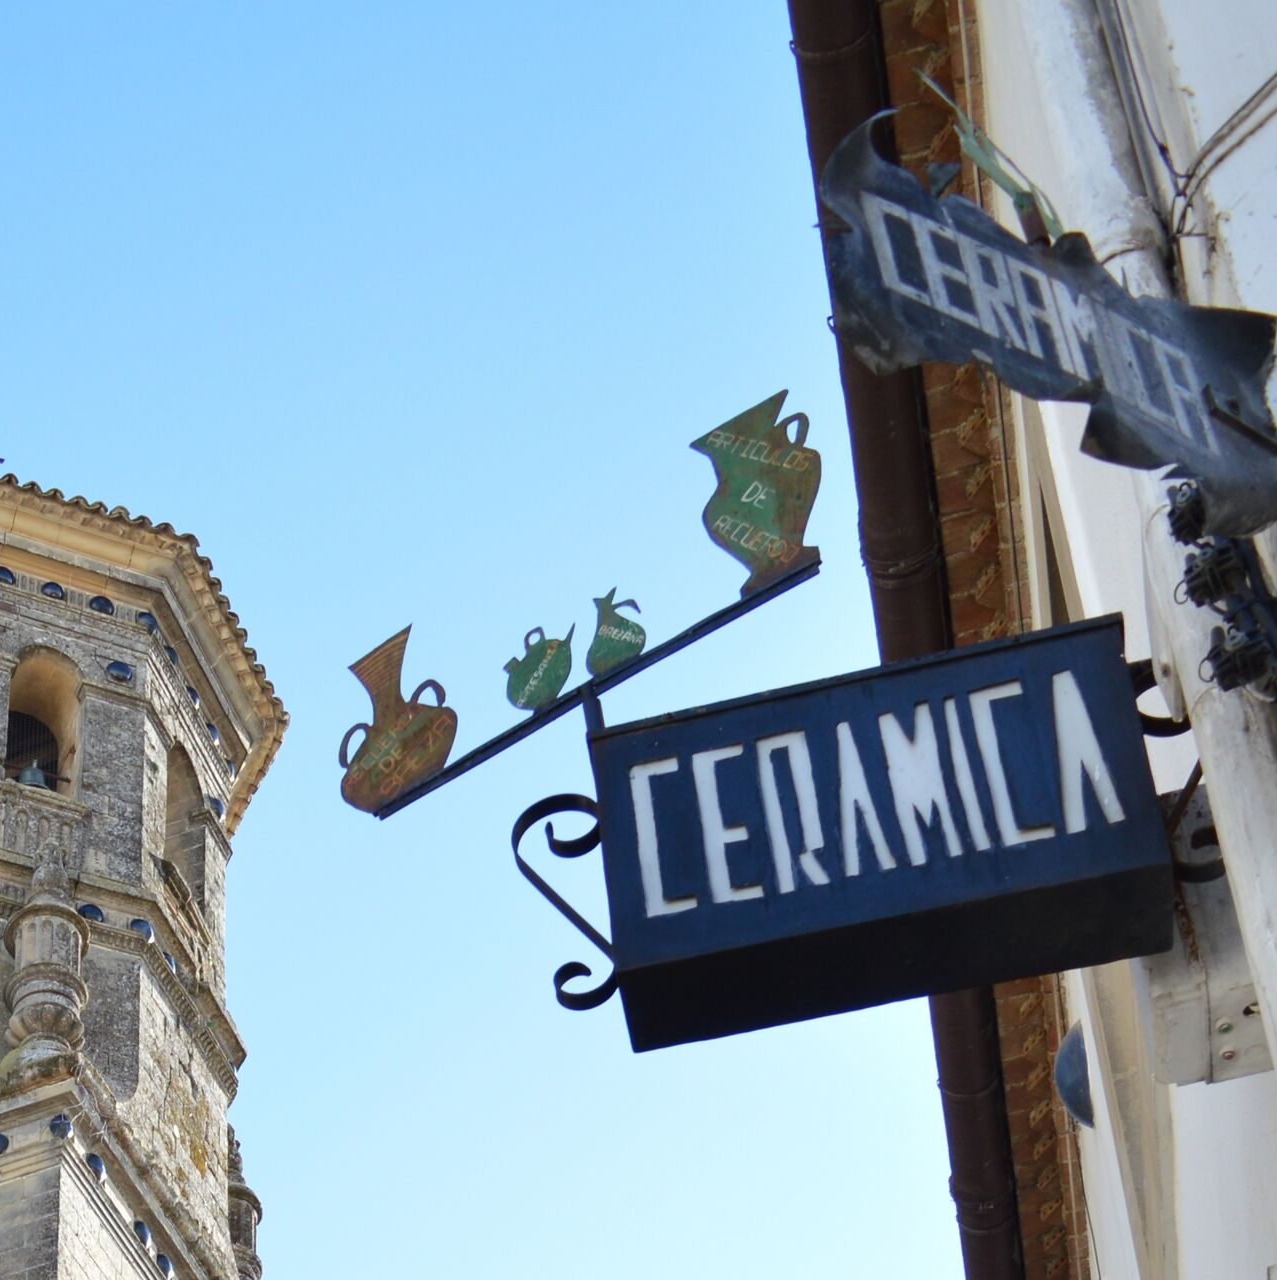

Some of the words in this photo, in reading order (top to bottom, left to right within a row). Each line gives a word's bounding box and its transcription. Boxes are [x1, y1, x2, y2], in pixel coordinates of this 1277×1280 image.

[859, 192, 1220, 456] CERAMICA
[706, 430, 814, 473] ARTICULOS
[740, 481, 776, 509] DE
[628, 669, 1125, 919] CERAMICA
